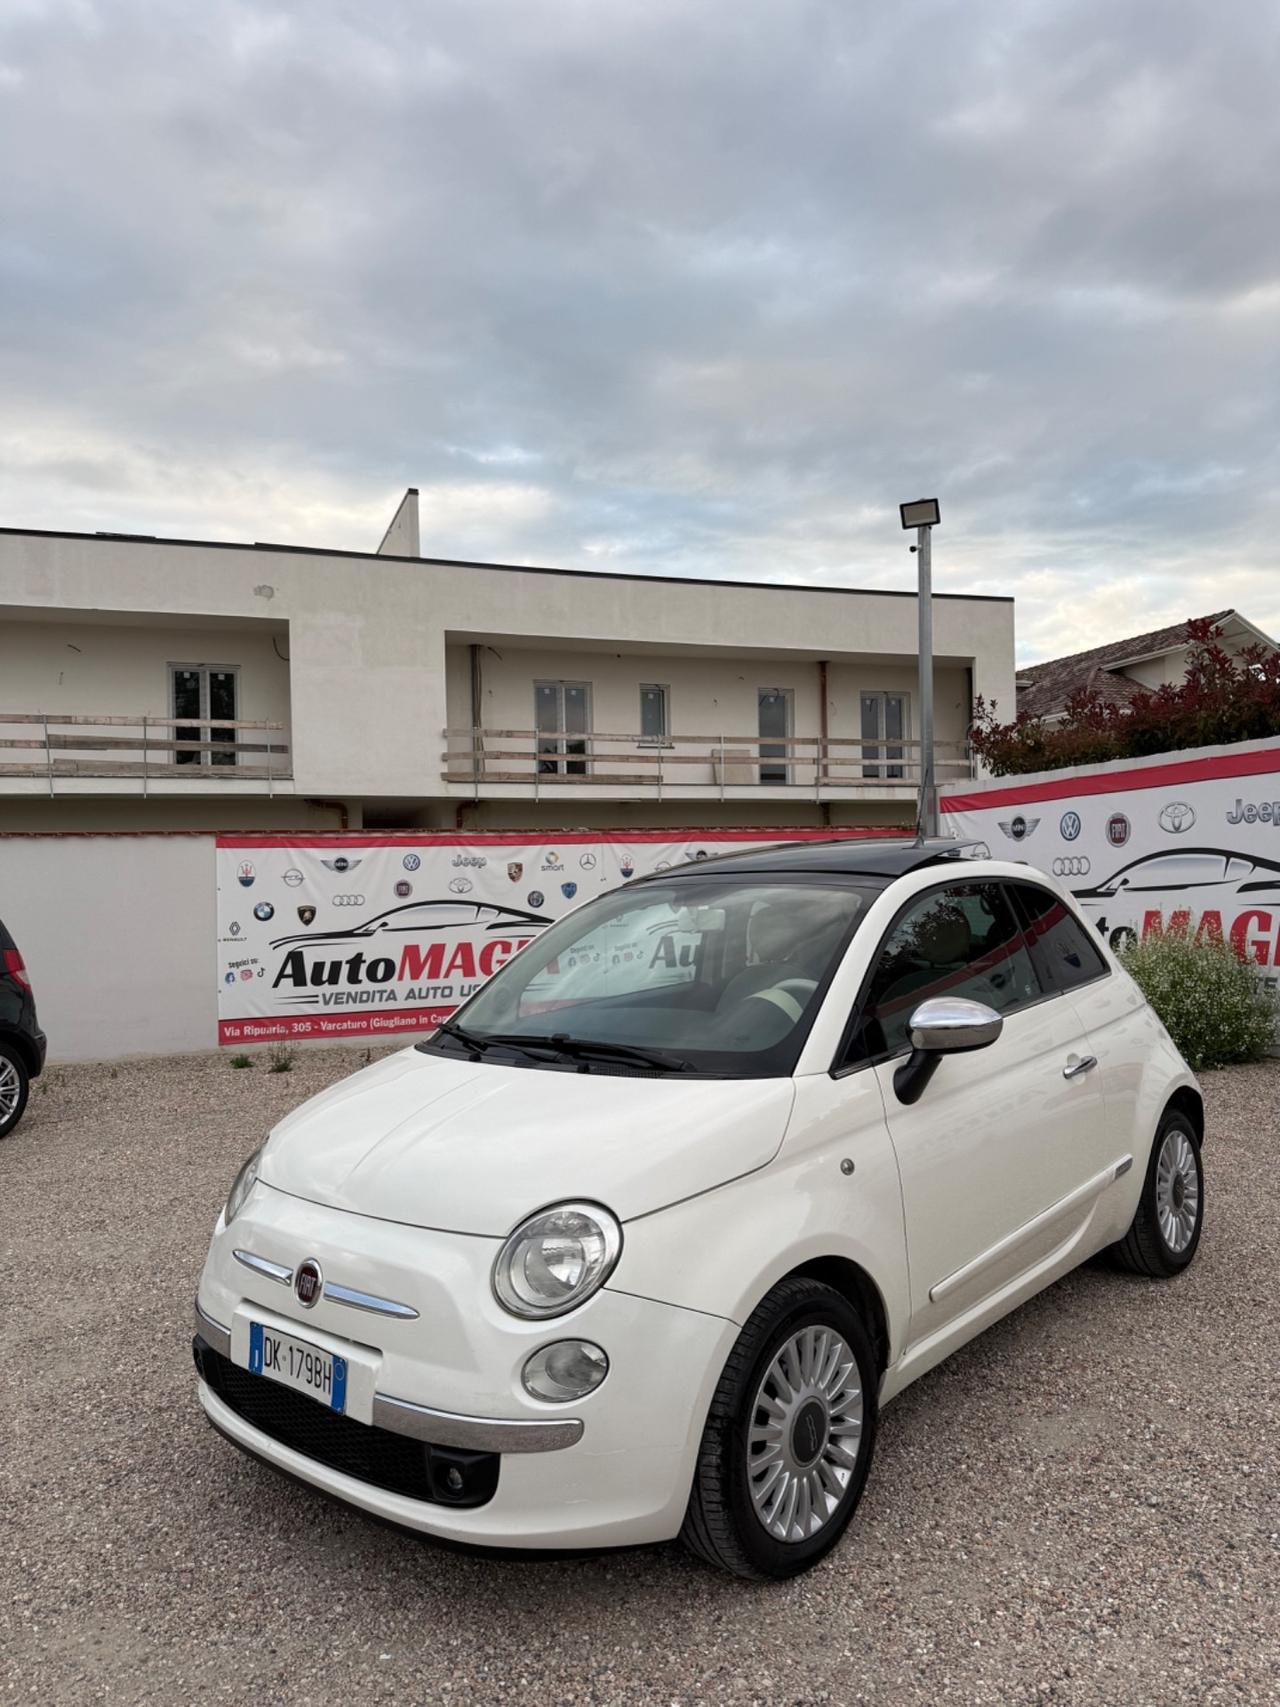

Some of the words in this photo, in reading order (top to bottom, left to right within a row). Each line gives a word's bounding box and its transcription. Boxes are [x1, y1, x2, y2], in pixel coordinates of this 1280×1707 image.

[1111, 823, 1126, 839] FIAT
[452, 854, 487, 869] Jeep
[541, 864, 564, 872] smart
[272, 939, 531, 989] AutoMAG
[321, 989, 398, 1006] VENDITA
[404, 985, 453, 1001] AUTO
[224, 1026, 240, 1037] Via
[292, 1022, 312, 1033] 305
[321, 1019, 367, 1031] Varcaturo
[369, 1016, 417, 1031] (Giugliano
[419, 1016, 428, 1025] in
[299, 1273, 316, 1297] FIAT
[264, 1335, 281, 1372] DK
[288, 1345, 332, 1396] 179BH
